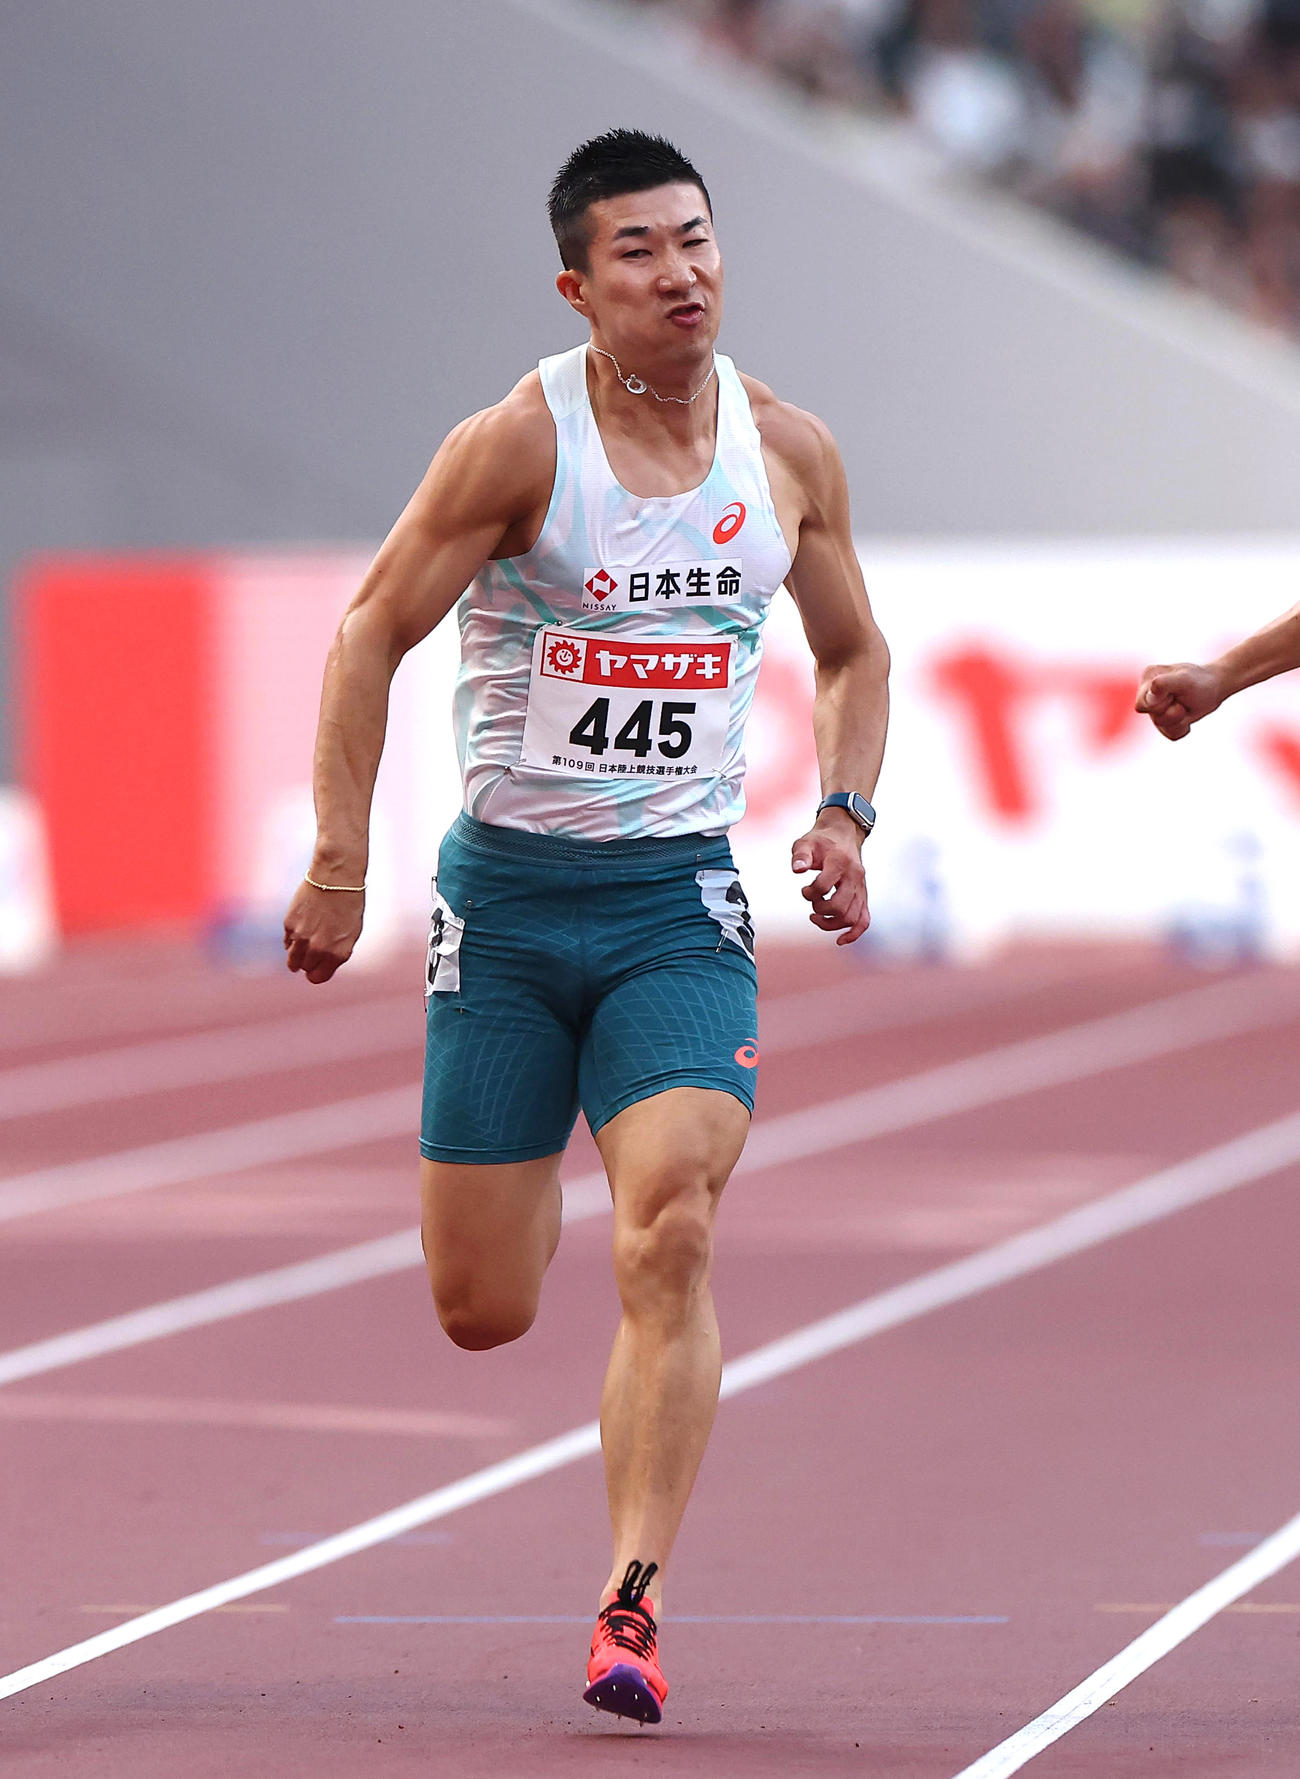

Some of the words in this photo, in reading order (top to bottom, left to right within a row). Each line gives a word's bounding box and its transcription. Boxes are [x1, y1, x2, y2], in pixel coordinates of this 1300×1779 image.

[629, 566, 742, 602] 日本生命
[582, 602, 617, 611] NISSAY
[595, 650, 722, 680] ヤマザキ
[568, 697, 697, 759] 445
[551, 755, 595, 772] 第109回
[599, 763, 698, 776] 日本陸上競技選手権大会
